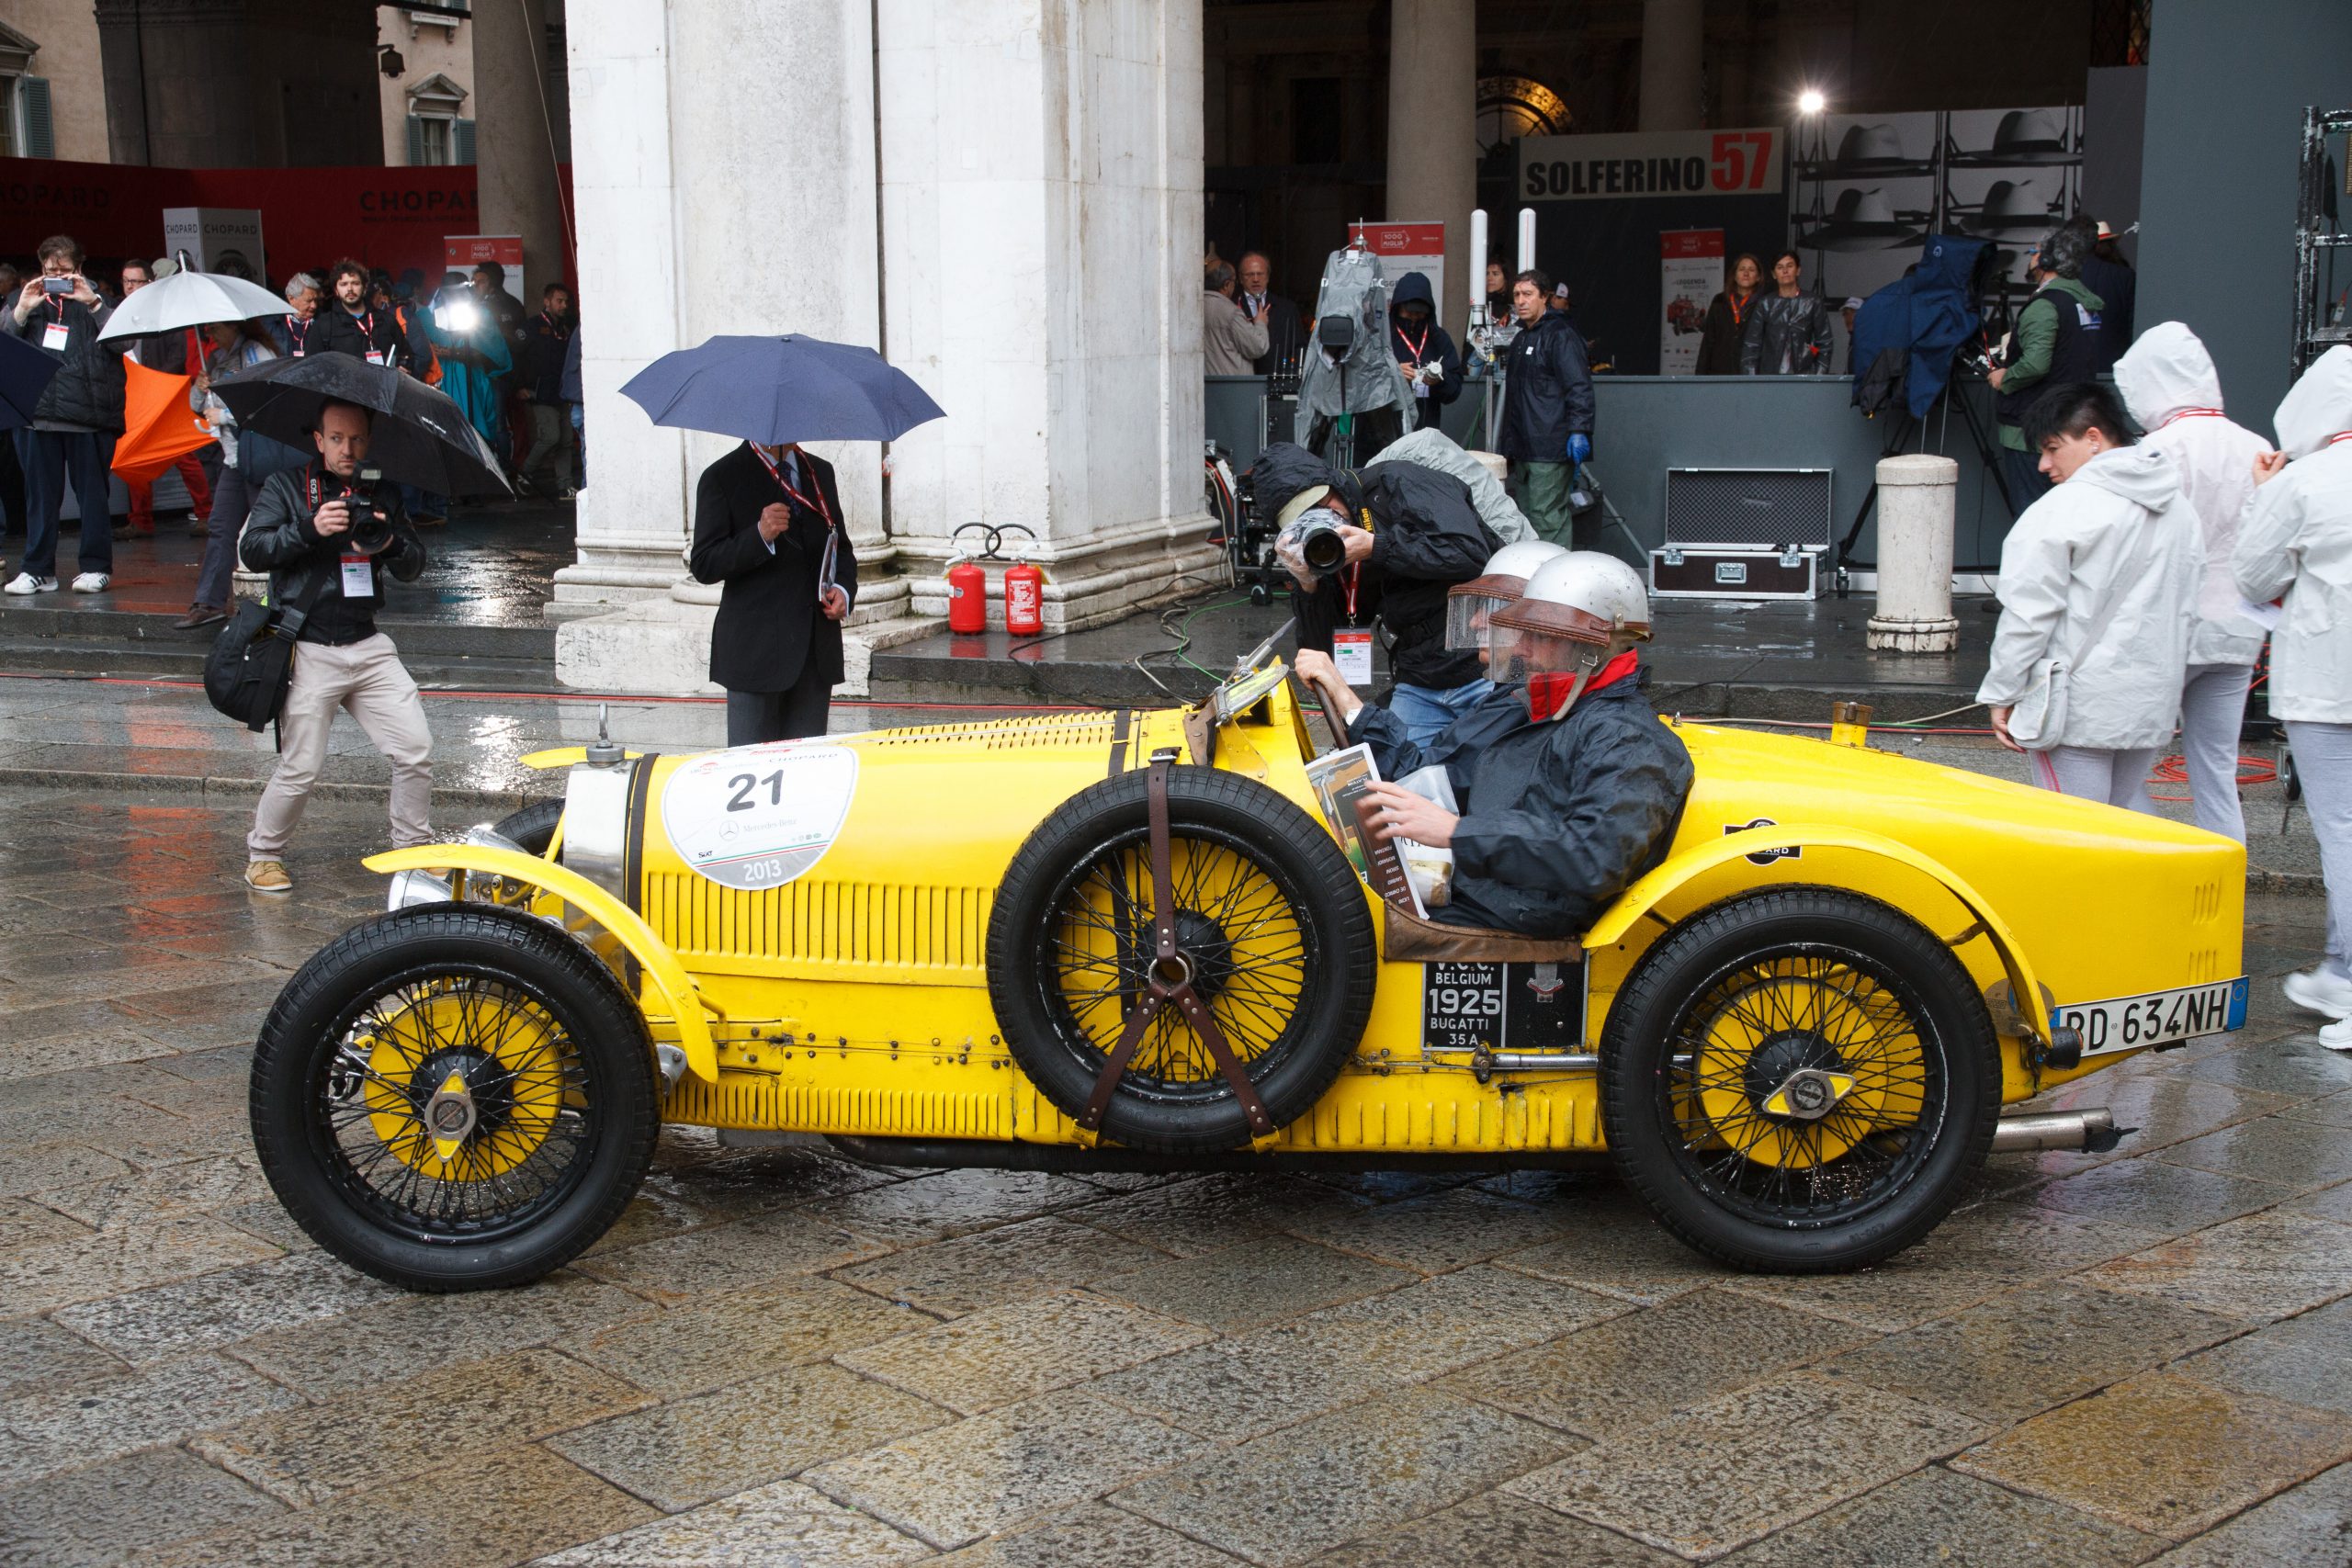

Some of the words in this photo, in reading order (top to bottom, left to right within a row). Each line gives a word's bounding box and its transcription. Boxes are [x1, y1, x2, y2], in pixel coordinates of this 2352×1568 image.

[1526, 157, 1705, 196] SOLFERINO
[1711, 132, 1772, 191] 57
[0, 183, 109, 209] OPARD
[360, 190, 478, 211] CHOPA
[165, 223, 198, 234] CHOPARD
[204, 224, 257, 235] CHOPARD
[310, 479, 318, 494] EOS
[1361, 509, 1373, 531] Nikon
[726, 769, 784, 812] 21
[743, 859, 782, 882] 2013
[1435, 973, 1492, 985] BELGIUM
[1429, 988, 1500, 1015] 1925
[1430, 1018, 1488, 1030] BUGATTI
[2122, 987, 2227, 1043] 634NH
